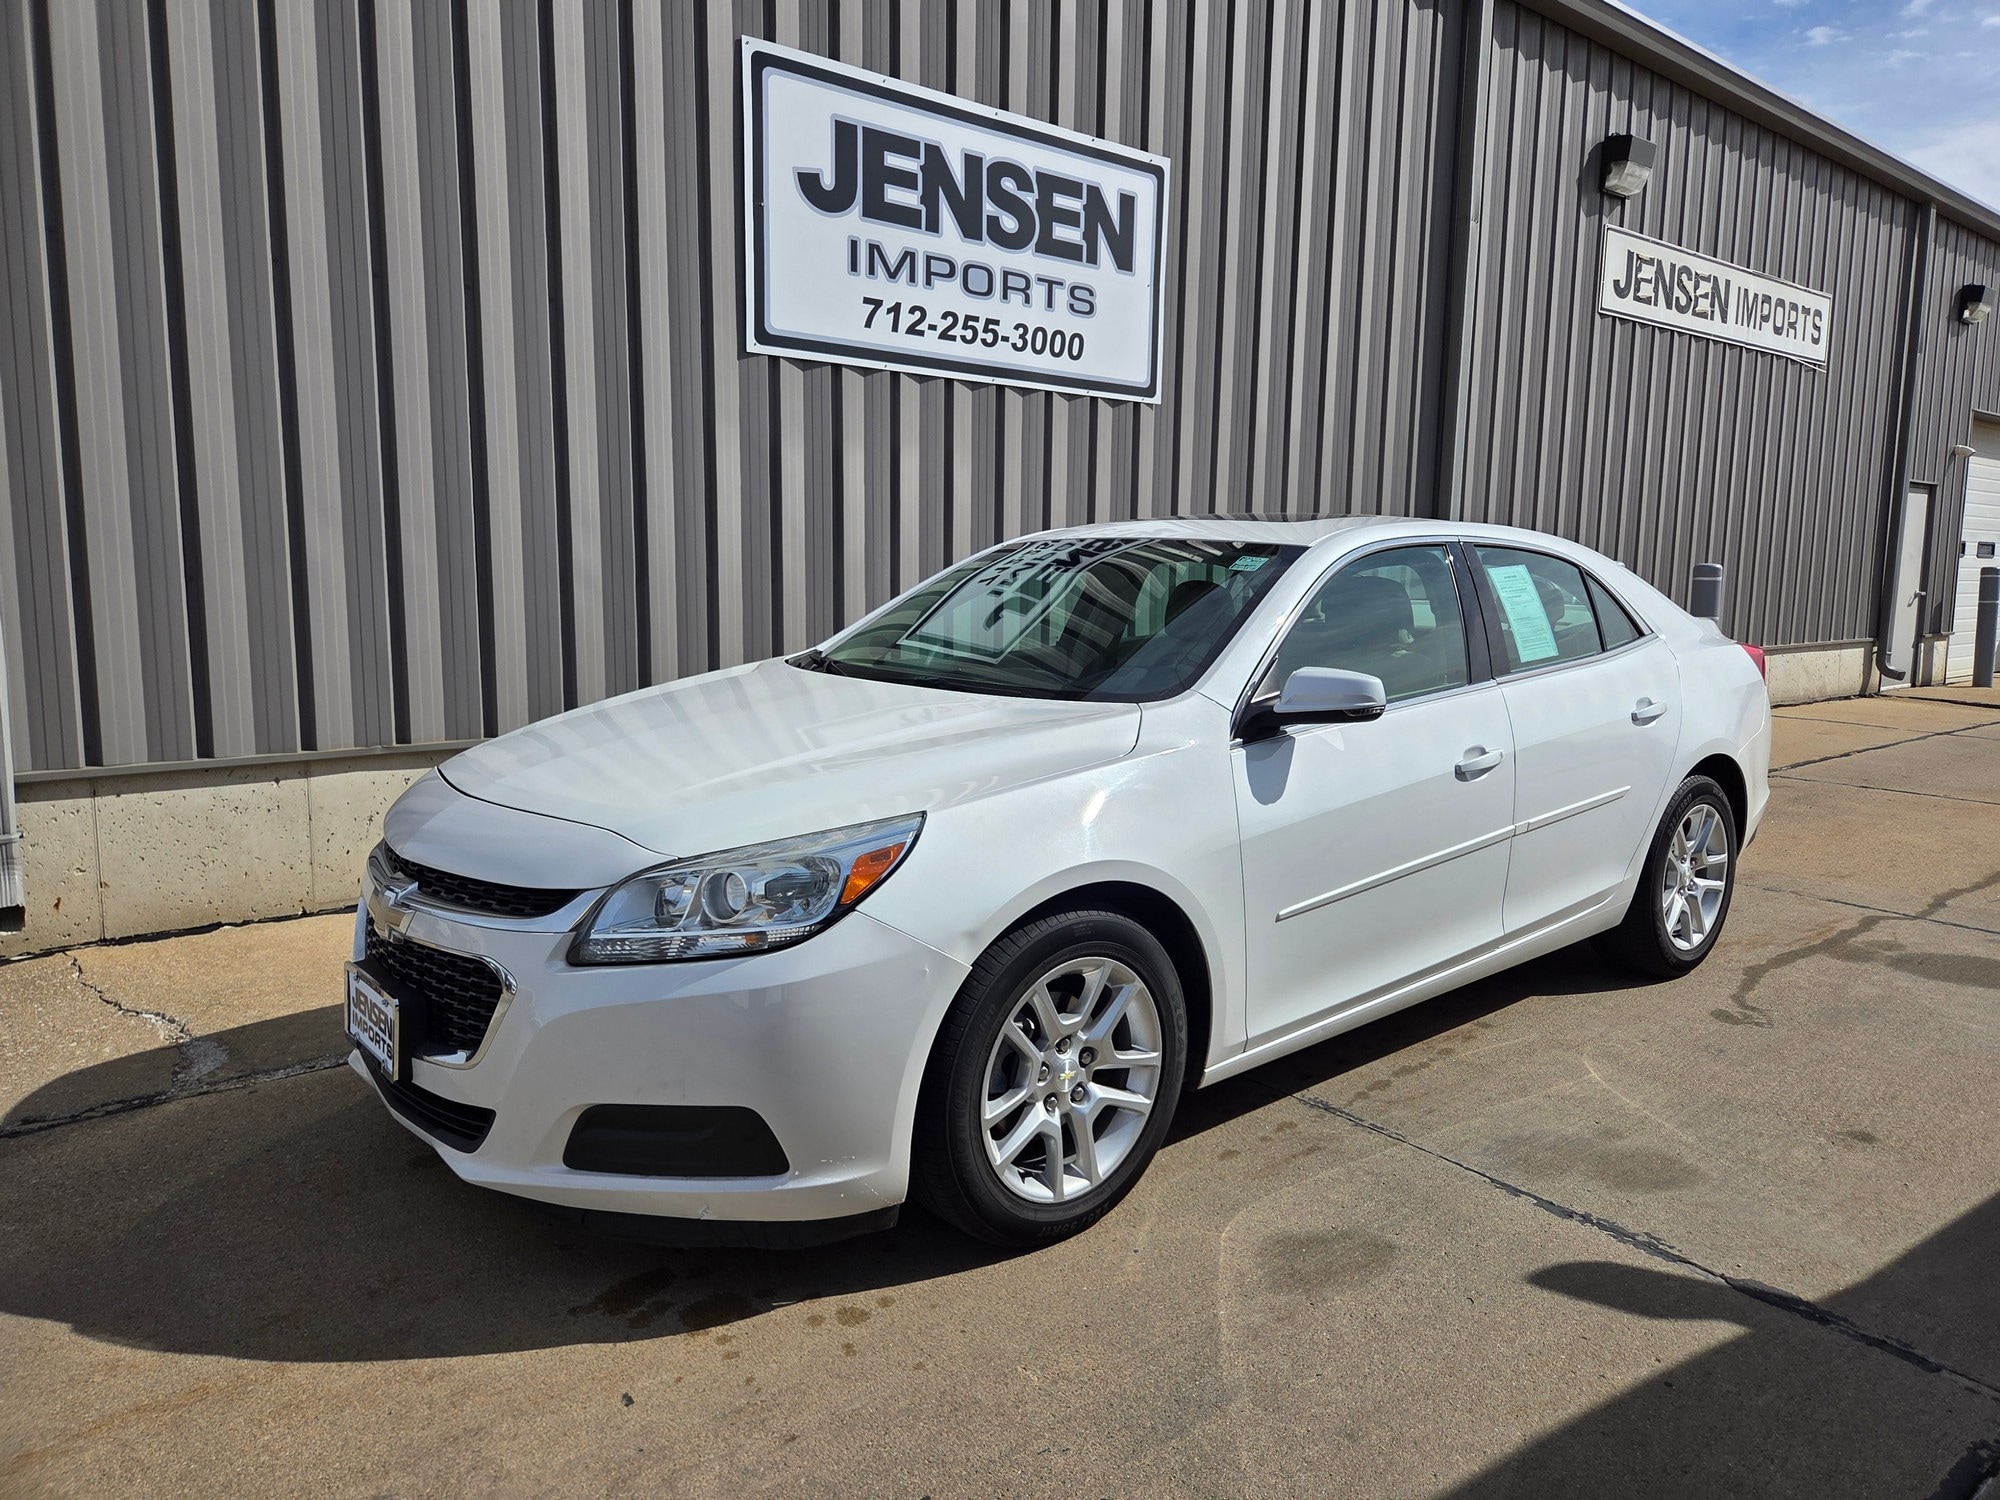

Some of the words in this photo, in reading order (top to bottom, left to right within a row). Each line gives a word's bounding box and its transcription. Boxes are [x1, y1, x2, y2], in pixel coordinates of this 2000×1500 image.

[794, 115, 1137, 275] JENSEN
[848, 237, 1096, 317] IMPORTS
[1613, 249, 1731, 324] JENSEN
[1735, 286, 1822, 345] IMPORTS
[862, 296, 1085, 361] 712-255-3000
[352, 987, 392, 1042] JENSEN
[352, 1010, 393, 1060] IMPORTS
